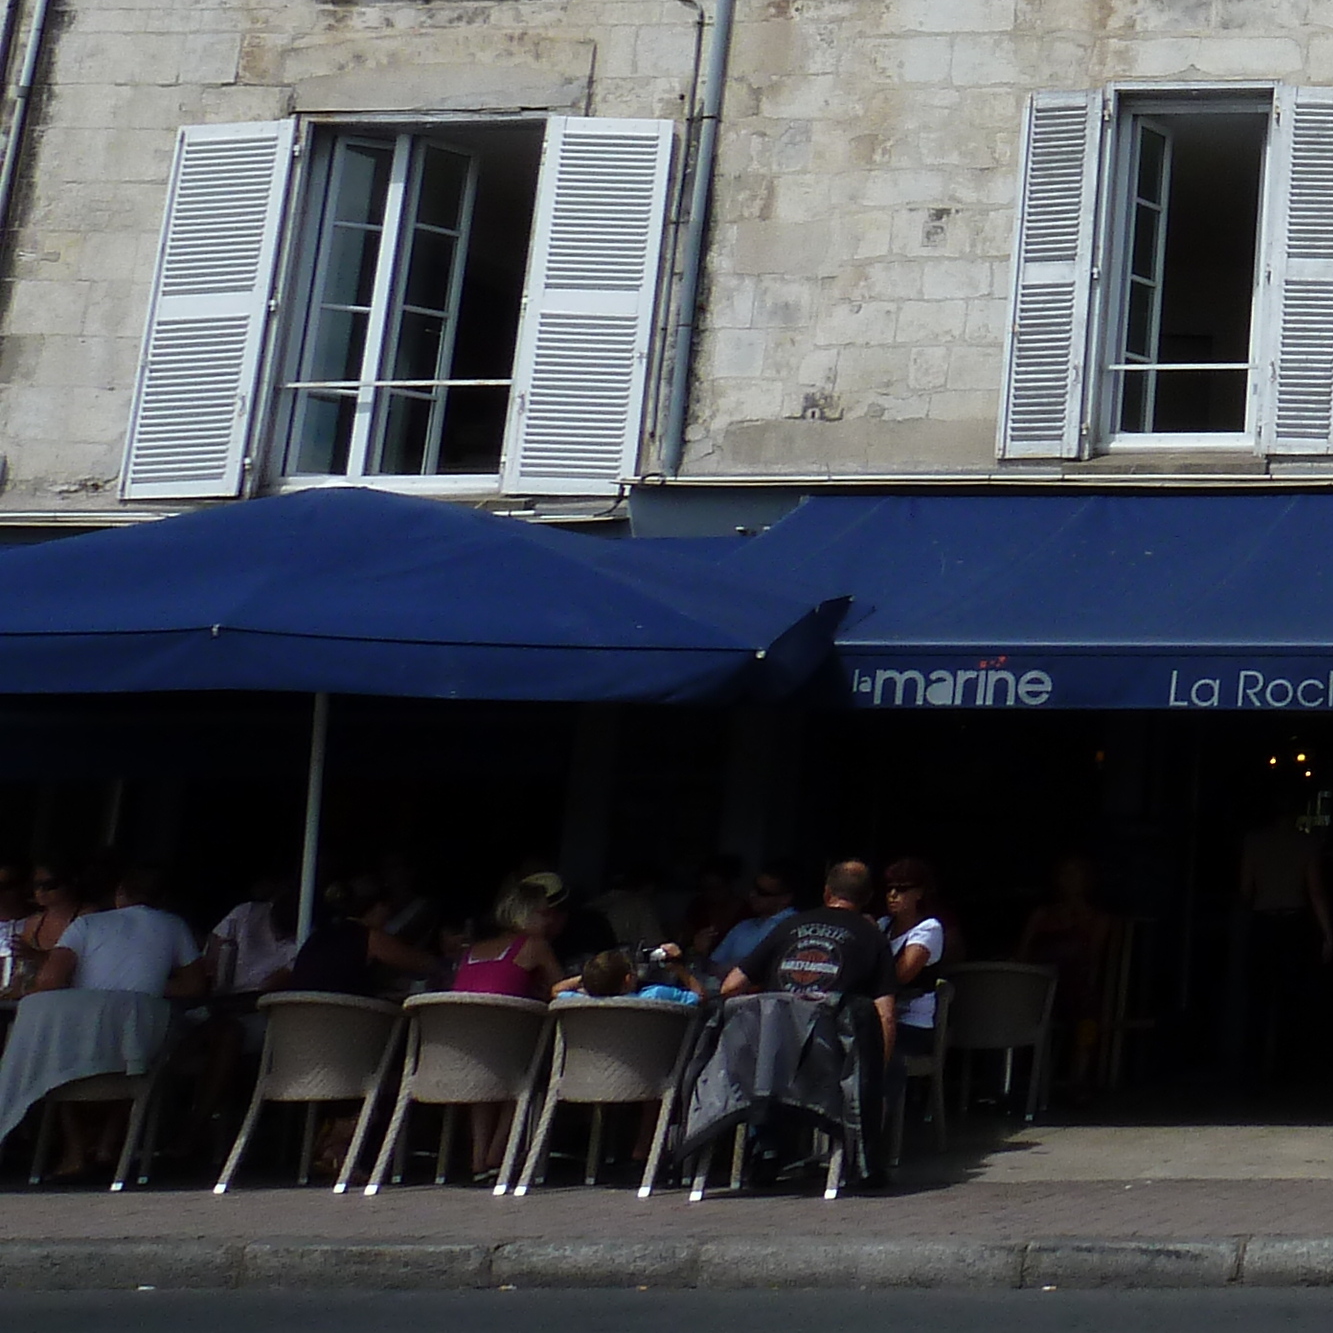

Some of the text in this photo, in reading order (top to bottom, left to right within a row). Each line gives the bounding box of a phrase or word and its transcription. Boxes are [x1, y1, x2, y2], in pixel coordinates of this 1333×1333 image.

[852, 669, 872, 692] la
[873, 663, 1053, 706] marine
[1170, 670, 1221, 707] La
